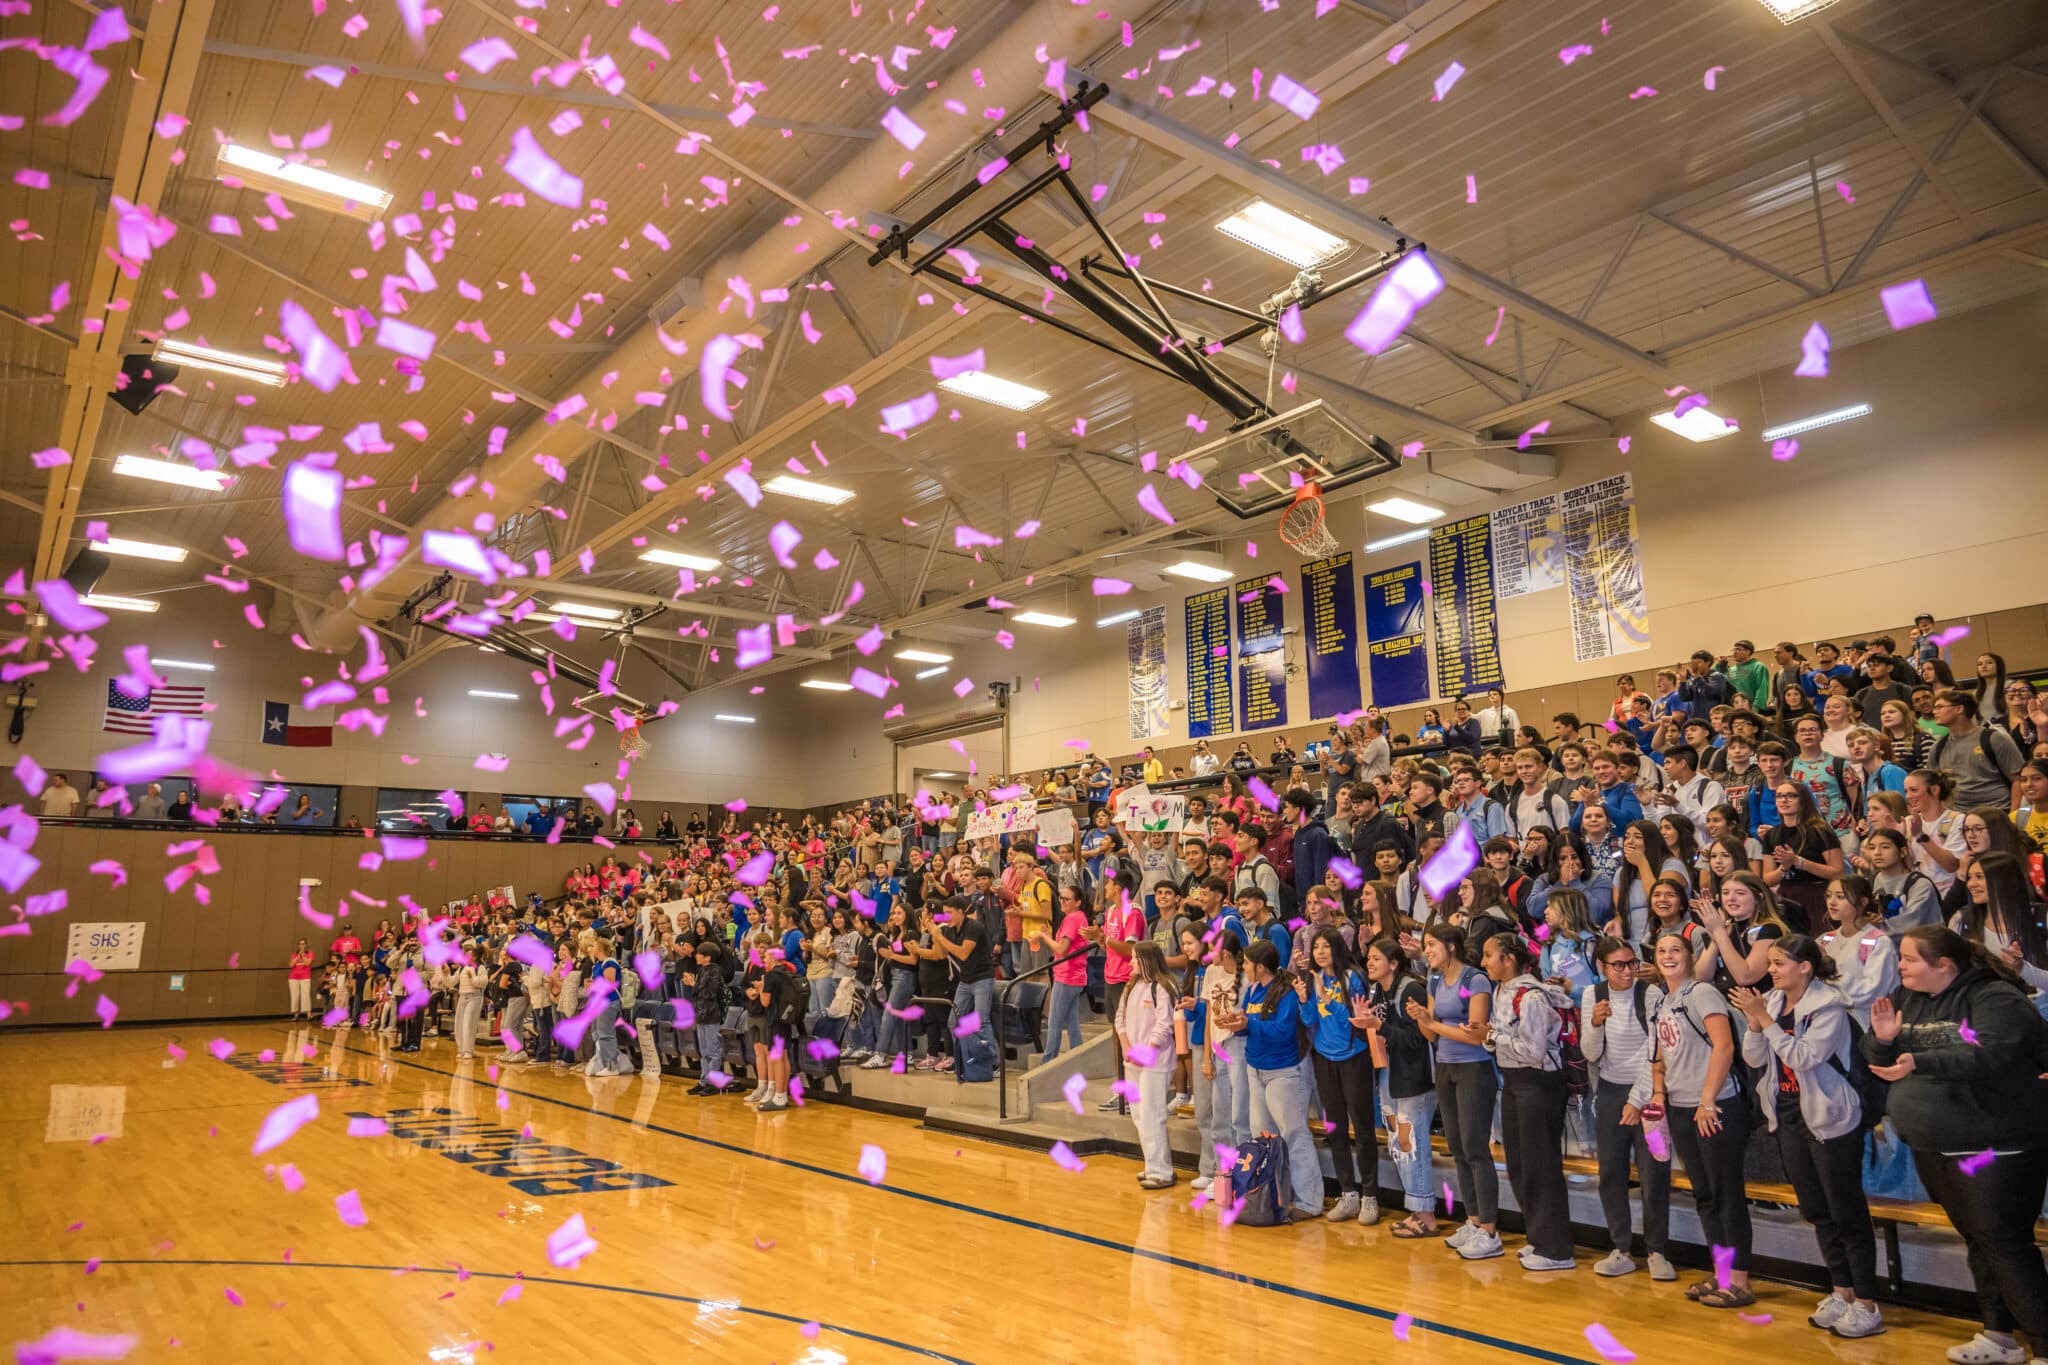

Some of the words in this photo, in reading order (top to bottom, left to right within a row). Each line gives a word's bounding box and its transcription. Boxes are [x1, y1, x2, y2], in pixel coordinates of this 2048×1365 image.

[1564, 484, 1596, 501] BOBCAT
[1597, 475, 1626, 491] TRACK
[1568, 496, 1588, 510] STATE
[1588, 486, 1625, 503] QUALIFIERS
[1493, 503, 1527, 521] LADYCAT
[1528, 495, 1556, 510] TRACK
[1498, 515, 1517, 528] STATE
[1517, 507, 1551, 523] QUALIFIERS
[89, 932, 121, 948] SHS
